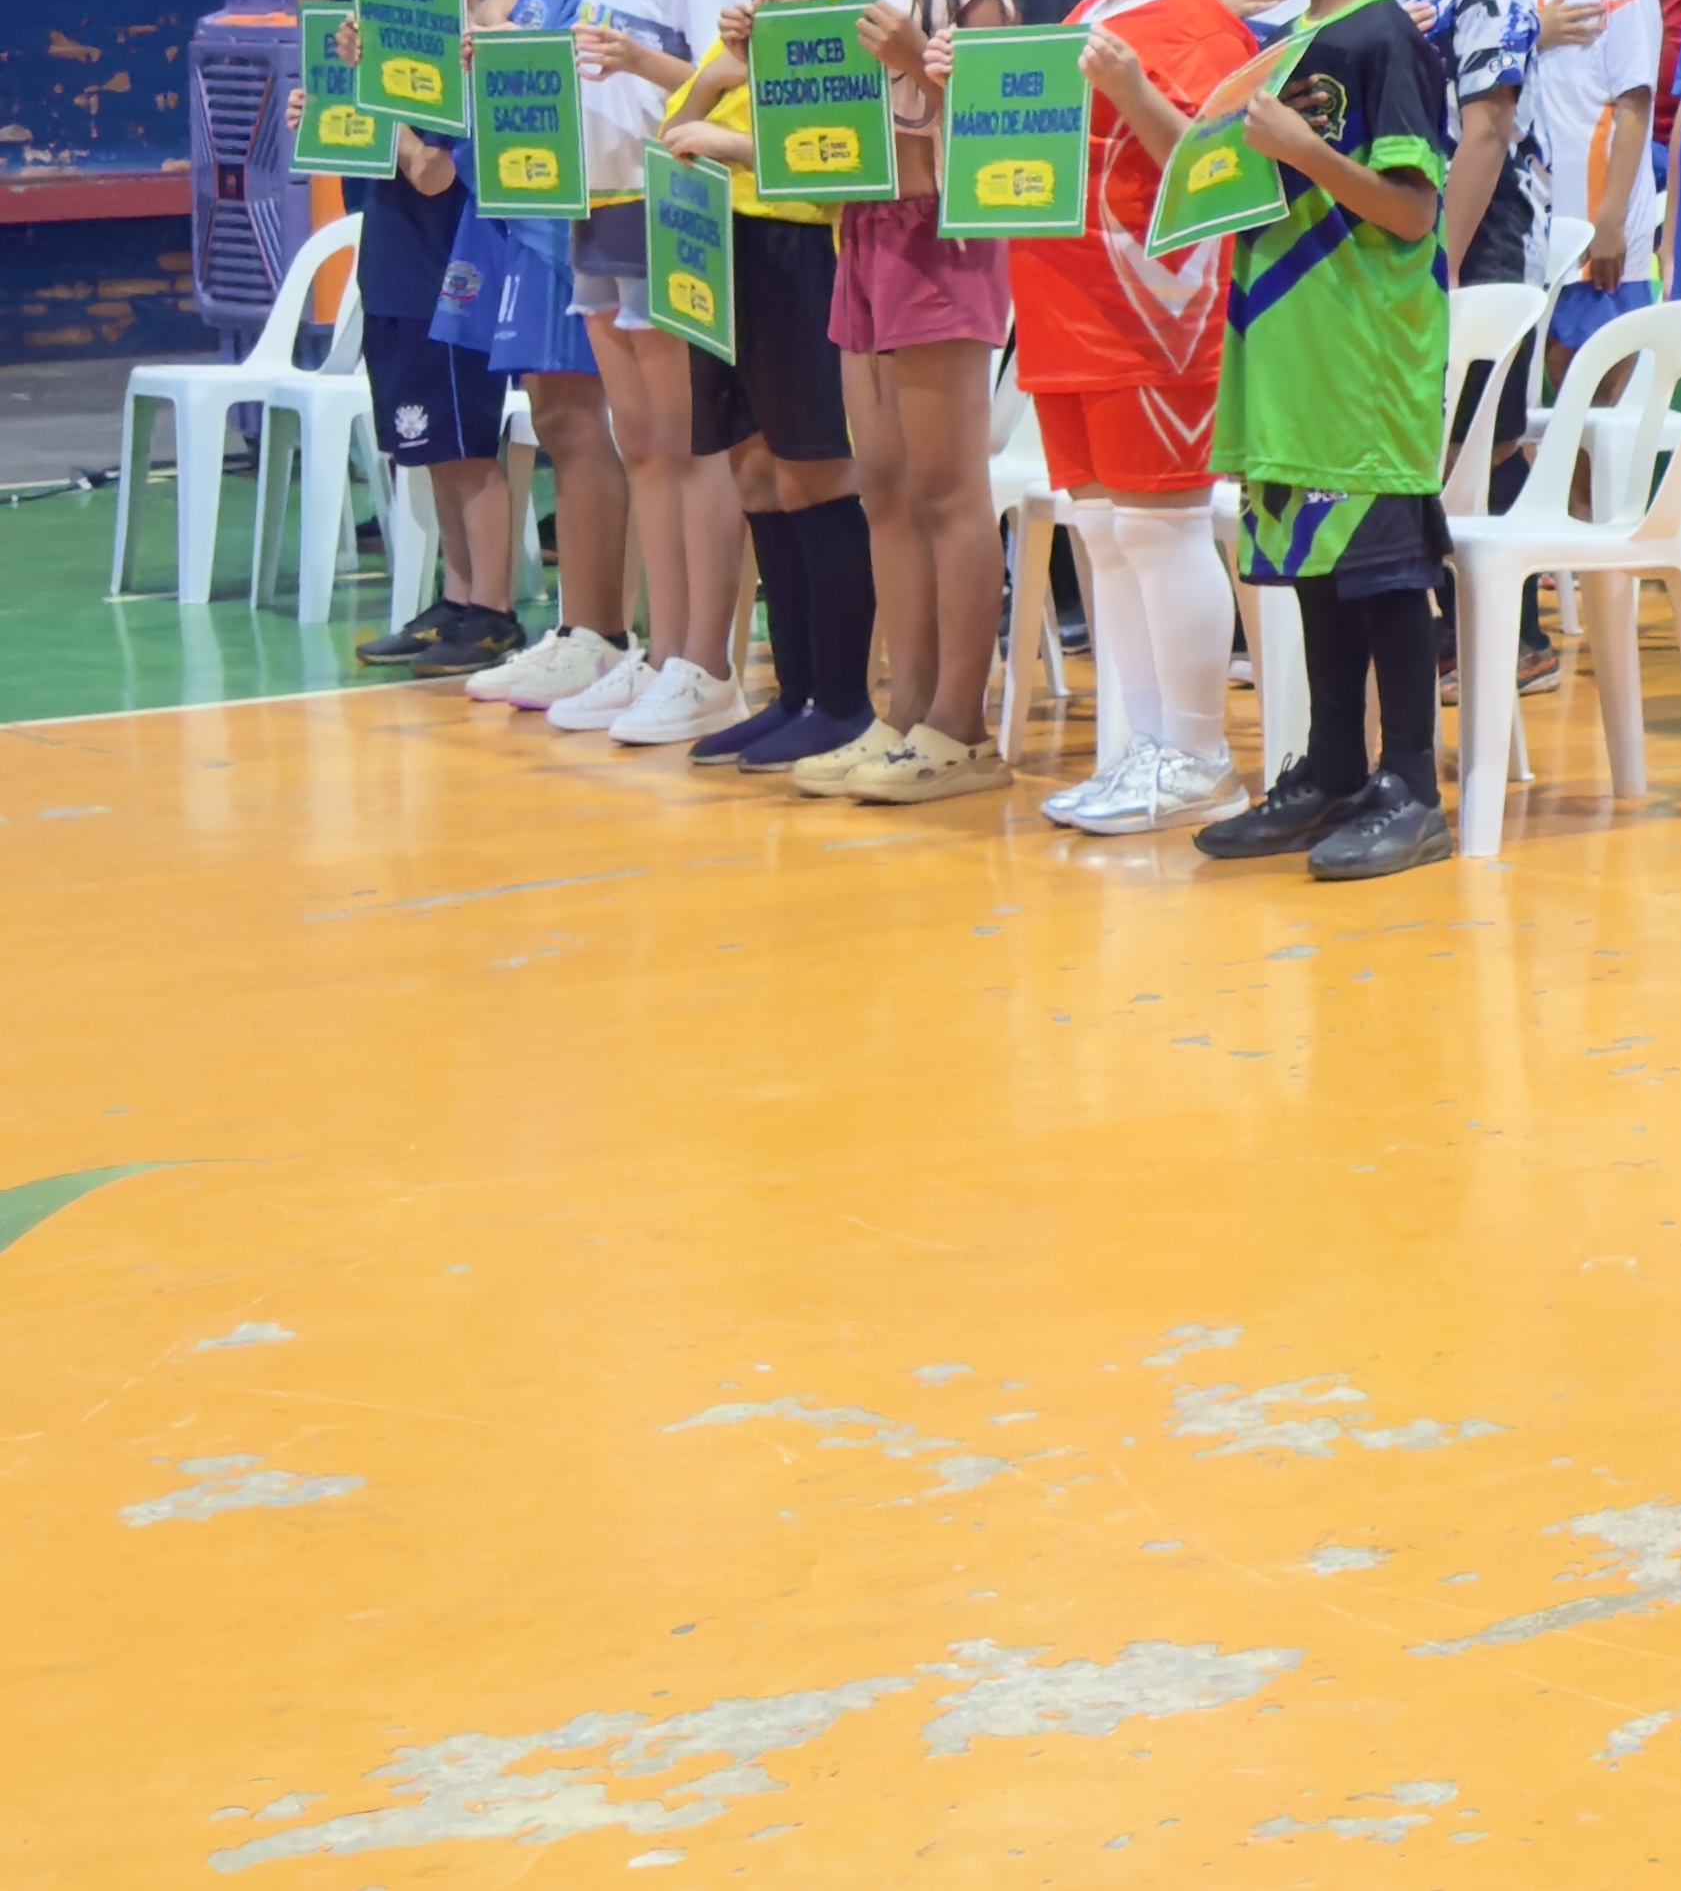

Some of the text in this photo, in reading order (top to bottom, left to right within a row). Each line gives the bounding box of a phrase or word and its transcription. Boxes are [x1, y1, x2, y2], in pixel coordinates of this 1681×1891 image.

[786, 37, 845, 66] EMCEB
[486, 61, 561, 97] BONIFÁCIO
[1001, 70, 1044, 98] EMEB
[494, 104, 559, 133] SACHETTI
